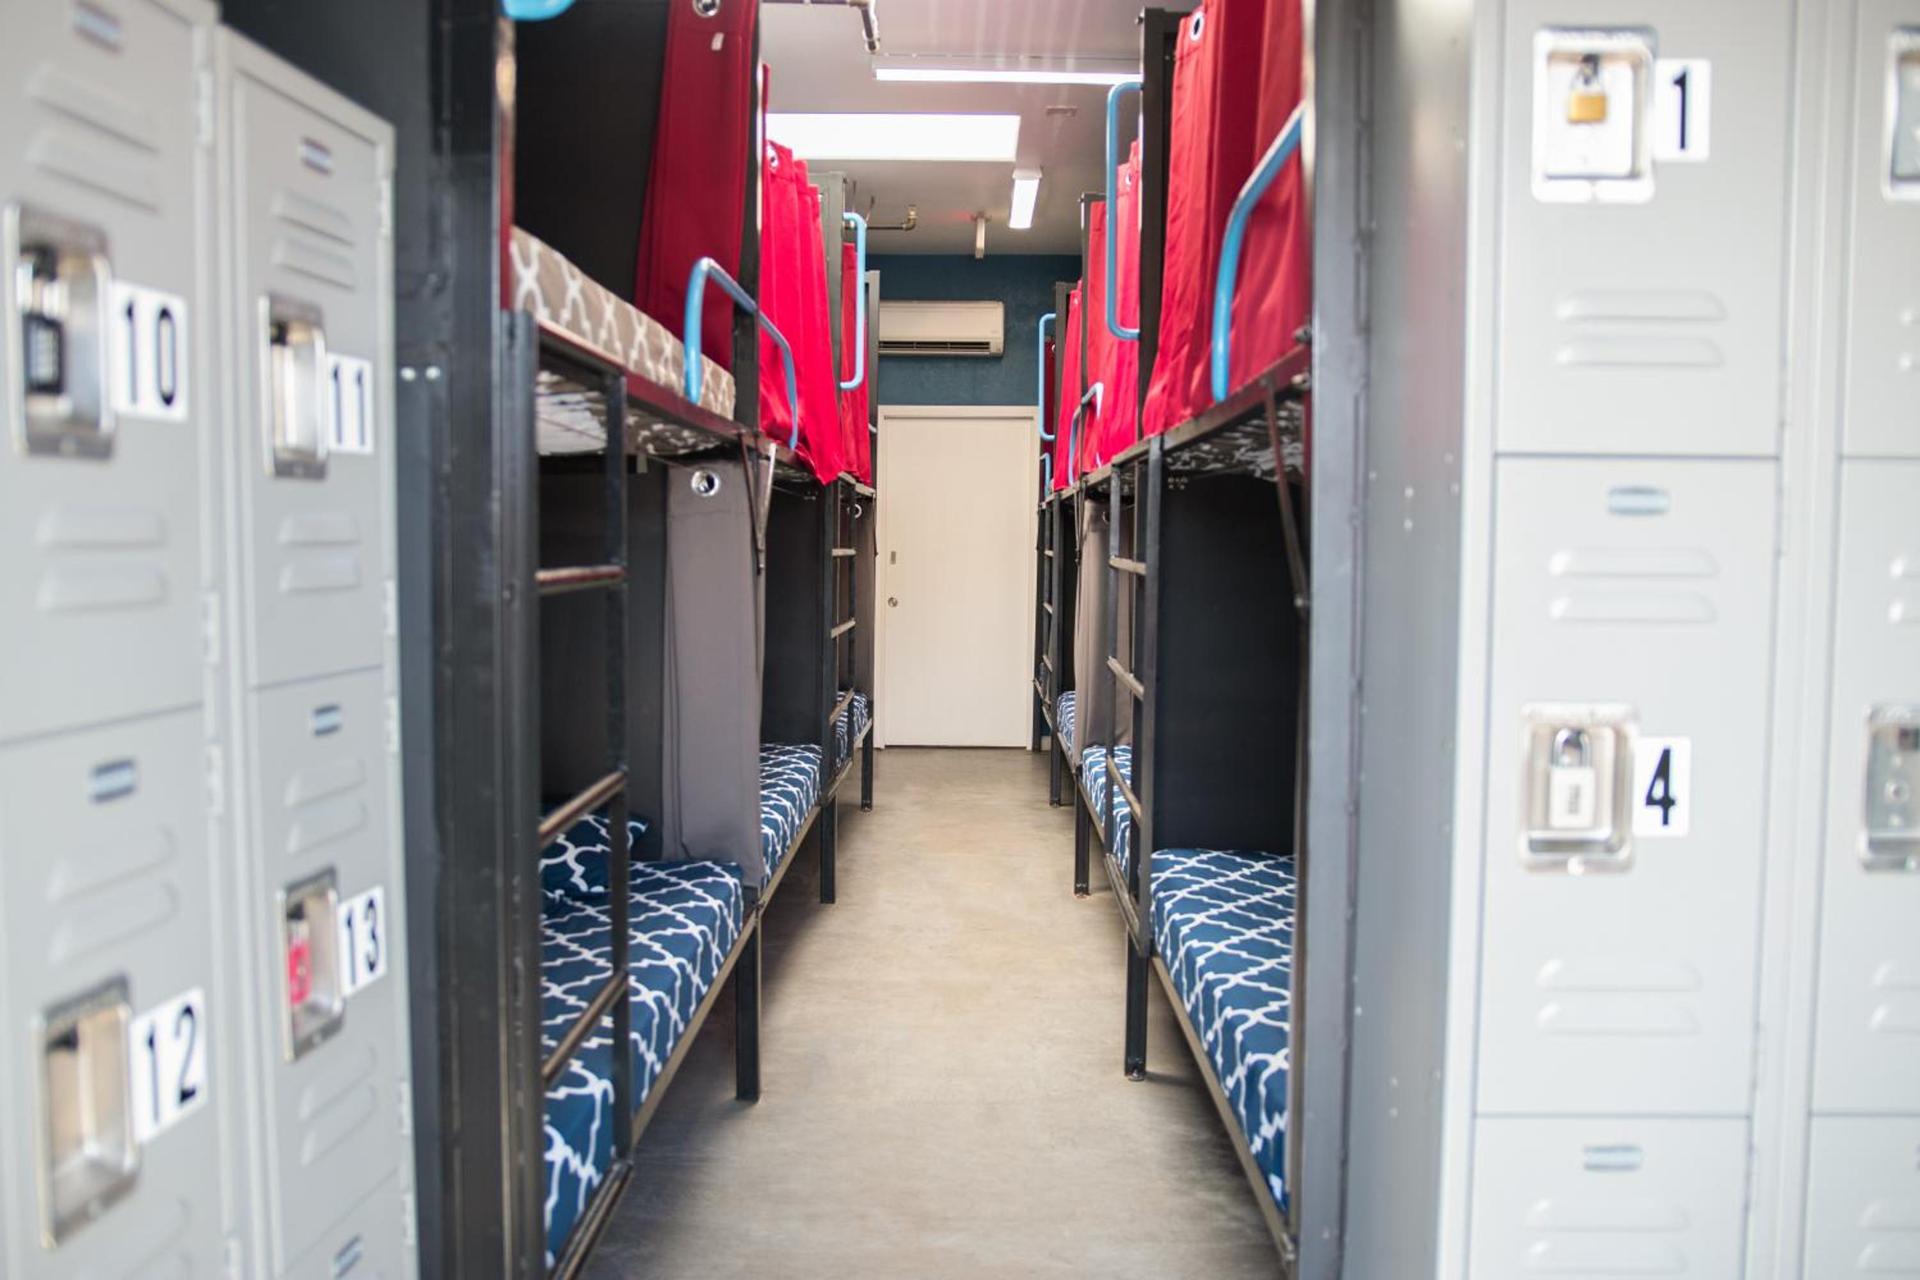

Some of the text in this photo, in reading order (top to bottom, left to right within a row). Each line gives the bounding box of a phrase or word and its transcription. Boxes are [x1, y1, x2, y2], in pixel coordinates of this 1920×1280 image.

[1671, 69, 1690, 151] 1
[123, 299, 177, 406] 10
[332, 364, 368, 444] 11
[1644, 747, 1677, 827] 4
[345, 897, 380, 985] 13
[146, 1003, 198, 1123] 12
